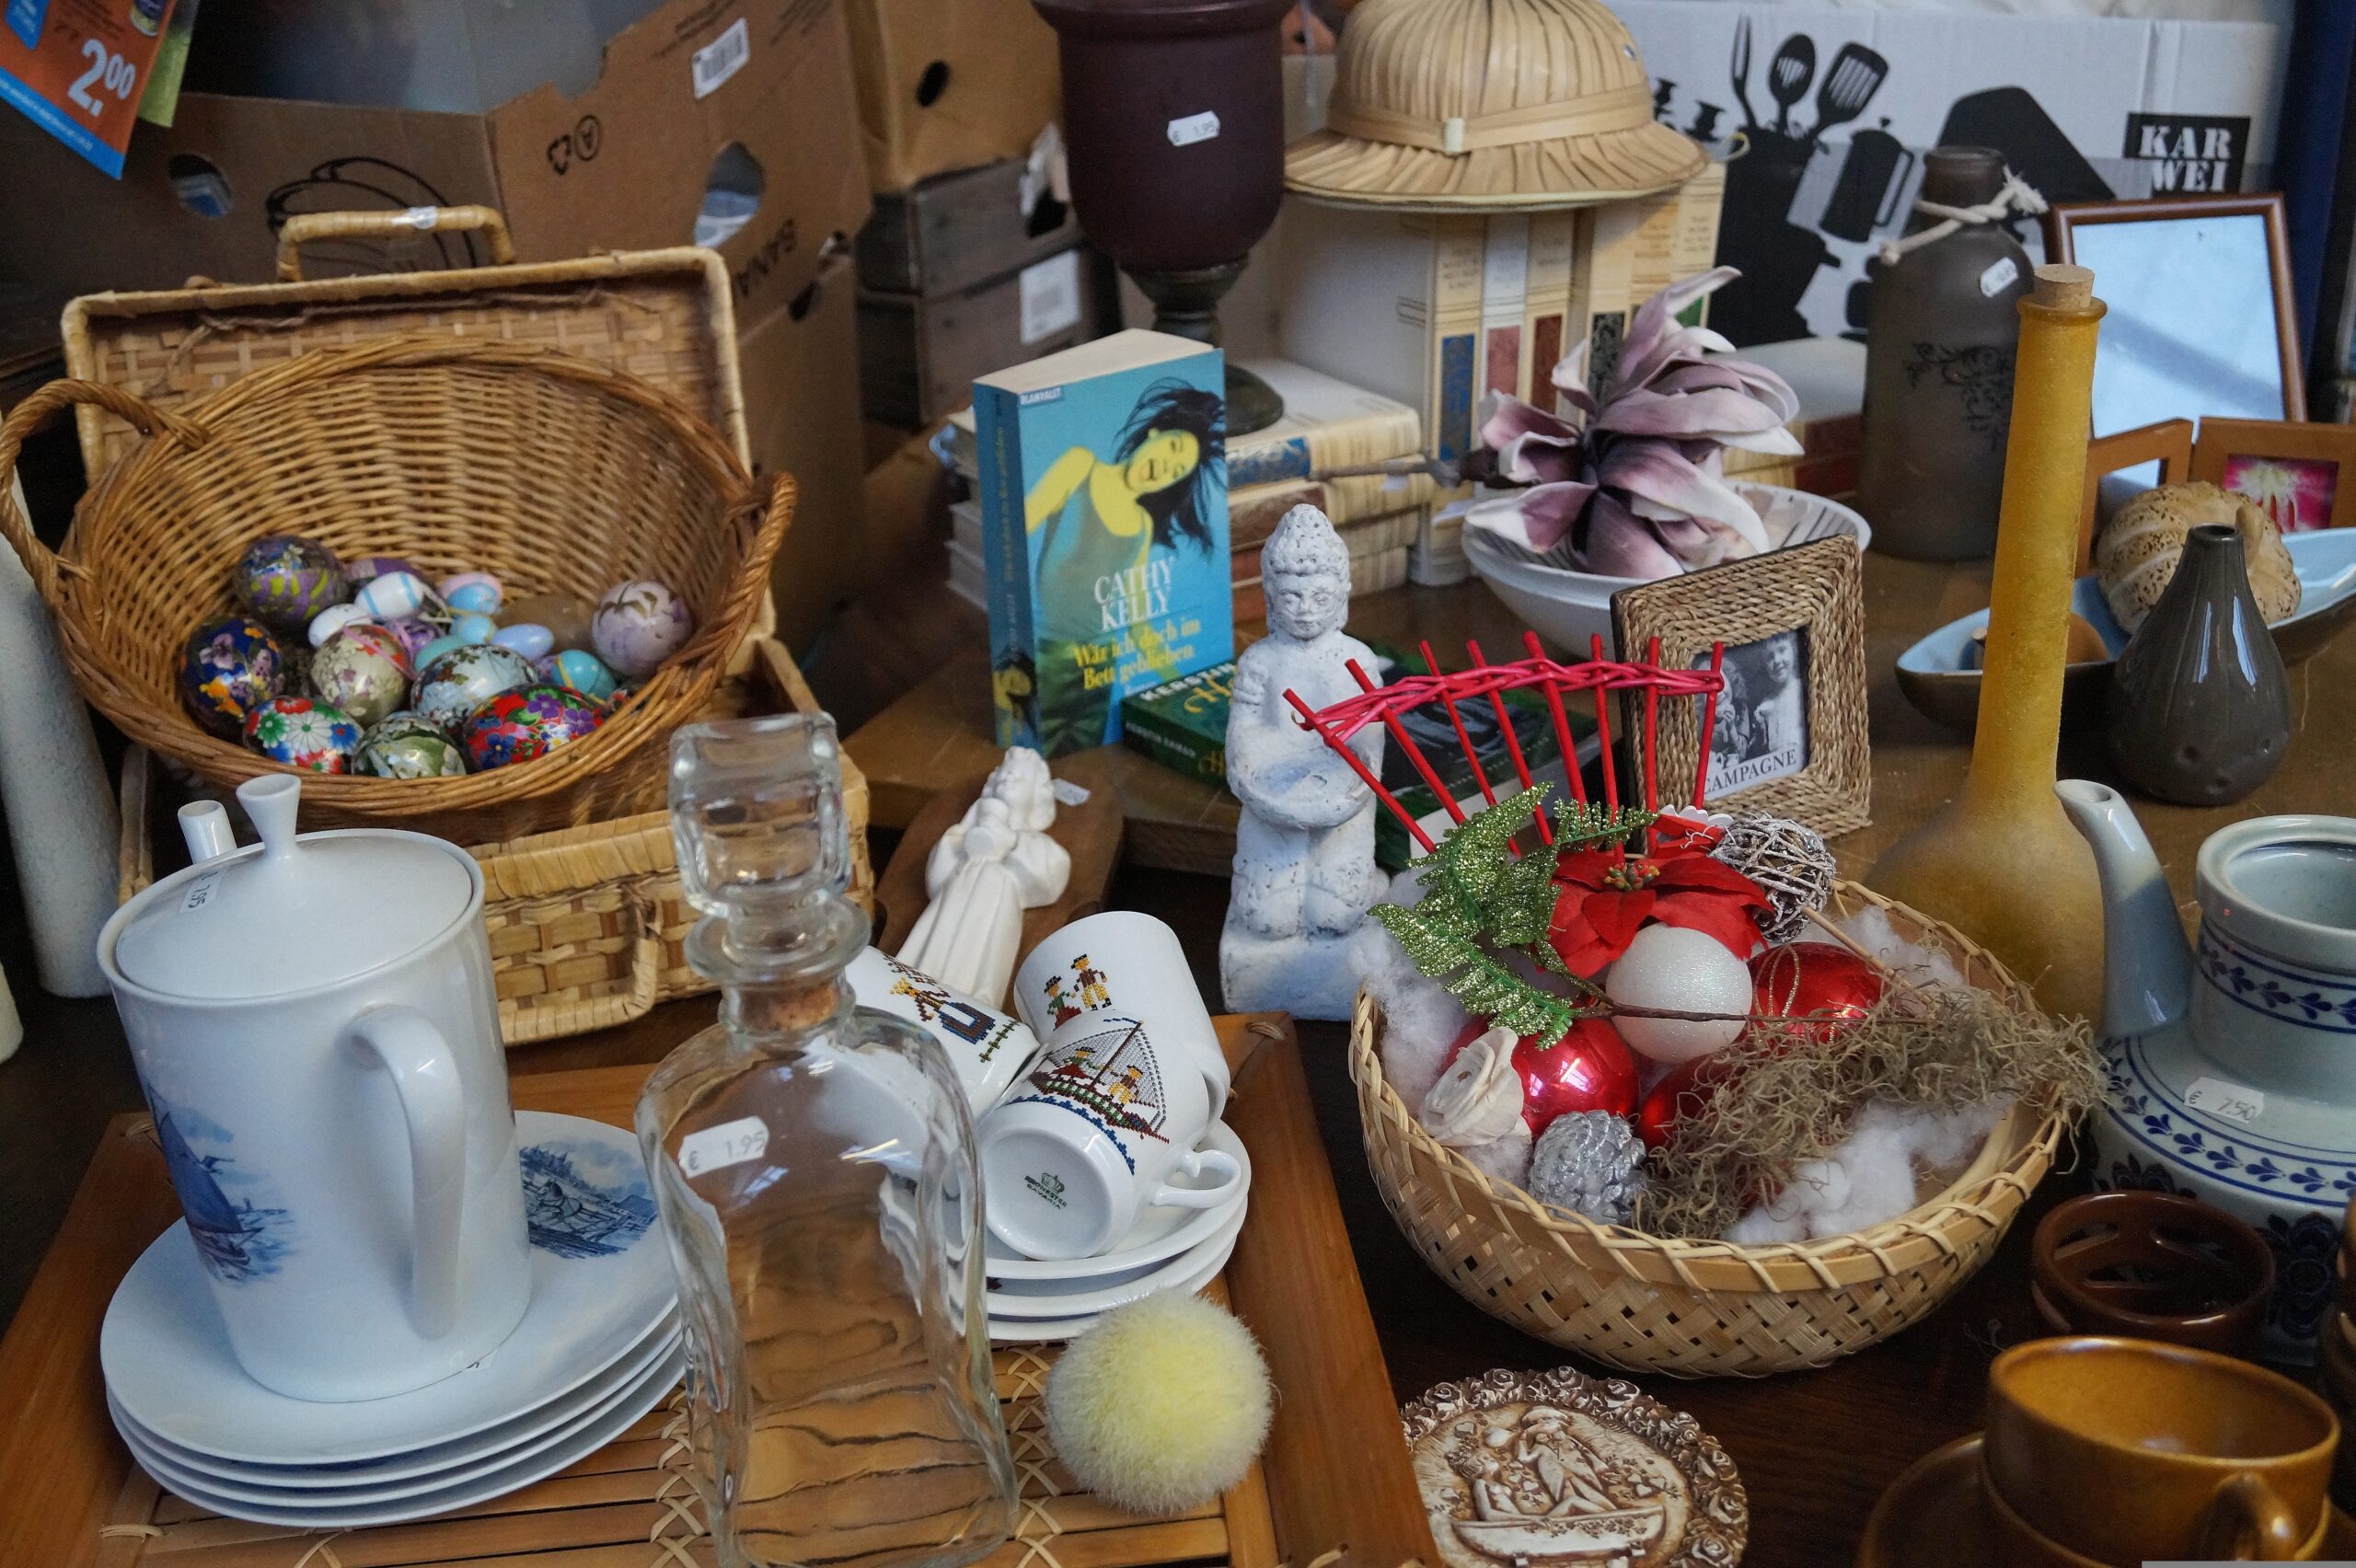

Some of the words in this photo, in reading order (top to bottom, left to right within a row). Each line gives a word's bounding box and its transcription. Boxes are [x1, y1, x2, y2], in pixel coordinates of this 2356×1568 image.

[2138, 125, 2232, 160] KAR
[2152, 159, 2228, 193] WEI
[1093, 555, 1177, 605] CATHY
[1101, 582, 1172, 633] KELLY
[1073, 642, 1108, 667] Wär
[1111, 630, 1135, 657] ich
[1138, 617, 1179, 650] doch
[1181, 614, 1202, 637] im
[1082, 665, 1116, 690] Bett
[1119, 643, 1195, 685] geblieben
[1138, 662, 1236, 702] KERSTIN
[2189, 1090, 2202, 1105] €
[687, 1149, 699, 1171] €
[724, 1129, 766, 1159] 1.95
[1026, 1182, 1061, 1210] BAVARIA
